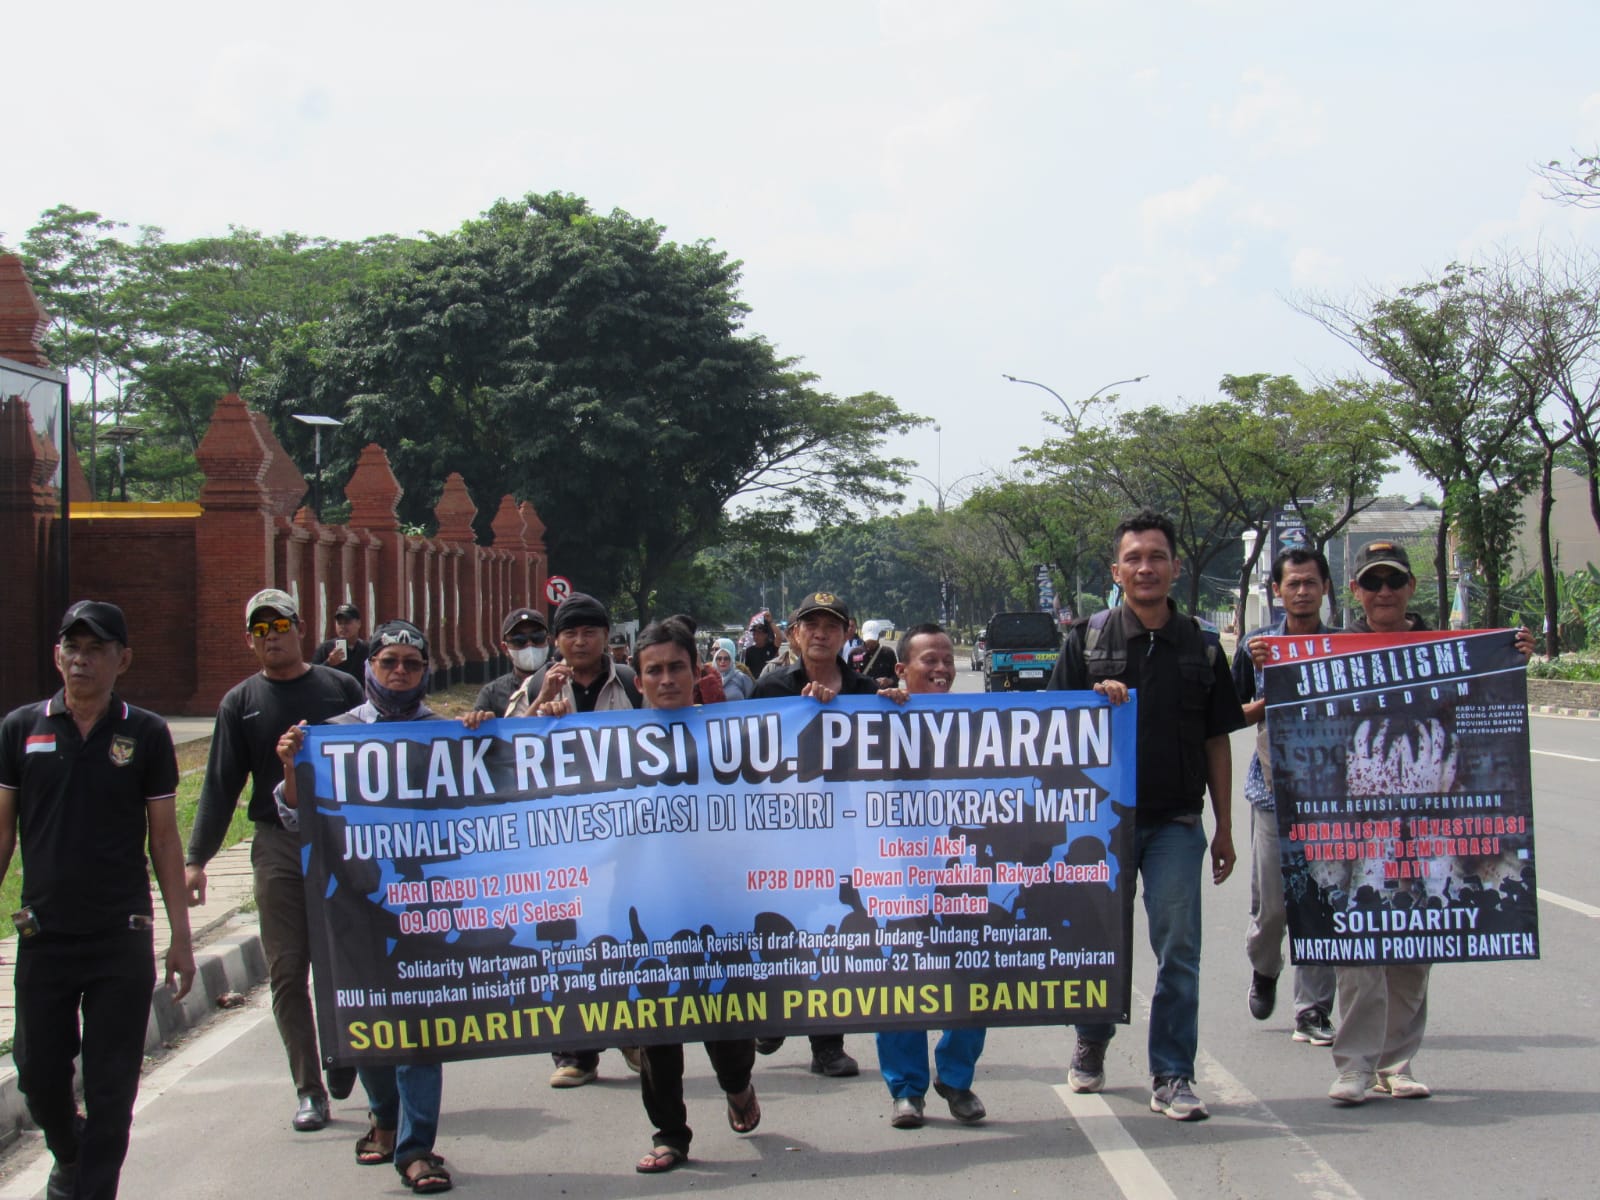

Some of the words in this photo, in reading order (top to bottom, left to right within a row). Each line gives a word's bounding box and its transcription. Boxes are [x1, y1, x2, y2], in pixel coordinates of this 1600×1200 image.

[1271, 637, 1332, 661] SAVE
[1297, 640, 1471, 696] JURNALISME
[1301, 682, 1470, 720] FREEDOM
[323, 737, 496, 802] TOLAK
[515, 723, 688, 791] REVISI
[706, 712, 798, 774] UU.
[822, 708, 1111, 771] PENYIARAN
[344, 814, 519, 860] JURNALISME
[527, 795, 698, 847] INVESTIGASI
[708, 794, 736, 831] DI
[745, 792, 834, 829] KEBIRI
[866, 789, 1023, 827] DEMOKRASI
[1035, 787, 1098, 822] MATI
[1289, 820, 1401, 841] JURNALISME
[1410, 816, 1526, 836] INVESTIGASI
[879, 837, 928, 859] Lokasi
[933, 836, 966, 858] Aksi
[1304, 841, 1385, 861] DIKEBIRI
[1394, 838, 1500, 857] DEMOKRASI
[387, 882, 428, 905] HARI
[432, 877, 477, 902] RABU
[481, 876, 499, 898] 12
[504, 872, 541, 896] JUNI
[547, 866, 589, 891] 2024
[747, 870, 788, 893] KP3B
[794, 869, 835, 890] DPRD
[852, 867, 902, 889] Dewan
[908, 864, 993, 887] Perwakilan
[998, 863, 1050, 889] Rakyat
[1054, 860, 1110, 882] Daerah
[1384, 861, 1431, 879] MATI
[400, 910, 450, 934] 09.00
[453, 906, 487, 929] WIB
[494, 902, 519, 929] s/d
[523, 897, 583, 923] Selesai
[867, 896, 929, 918] Provinsi
[934, 894, 989, 915] Banten
[1332, 907, 1480, 933] SOLIDARITY
[397, 954, 464, 980] Solidarity
[469, 953, 538, 975] Wartawan
[542, 944, 597, 967] Provinsi
[602, 939, 649, 960] Banten
[653, 933, 704, 956] menolak
[707, 931, 744, 952] Revisi
[747, 931, 763, 951] isi
[767, 929, 795, 950] draf
[798, 927, 871, 954] Rancangan
[875, 925, 980, 952] Undang-Undang
[984, 924, 1052, 948] Penyiaran.
[1294, 938, 1376, 961] WARTAWAN
[1382, 935, 1462, 958] PROVINSI
[1468, 932, 1534, 955] BANTEN
[337, 989, 364, 1008] RUU
[369, 986, 387, 1007] ini
[391, 985, 467, 1010] merupakan
[472, 978, 525, 1001] inisiatif
[531, 973, 560, 994] DPR
[564, 972, 597, 994] yang
[600, 963, 690, 989] direncanakan
[693, 960, 723, 982] untuk
[727, 956, 816, 980] menggantikan
[821, 957, 840, 974] UU
[845, 956, 888, 974] Nomor
[892, 955, 909, 971] 32
[913, 953, 950, 971] Tahun
[955, 951, 990, 969] 2002
[995, 949, 1046, 971] tentang
[1050, 948, 1115, 970] Penyiaran
[349, 1004, 566, 1050] SOLIDARITY
[579, 989, 767, 1032] WARTAWAN
[783, 983, 952, 1020] PROVINSI
[970, 979, 1108, 1012] BANTEN
